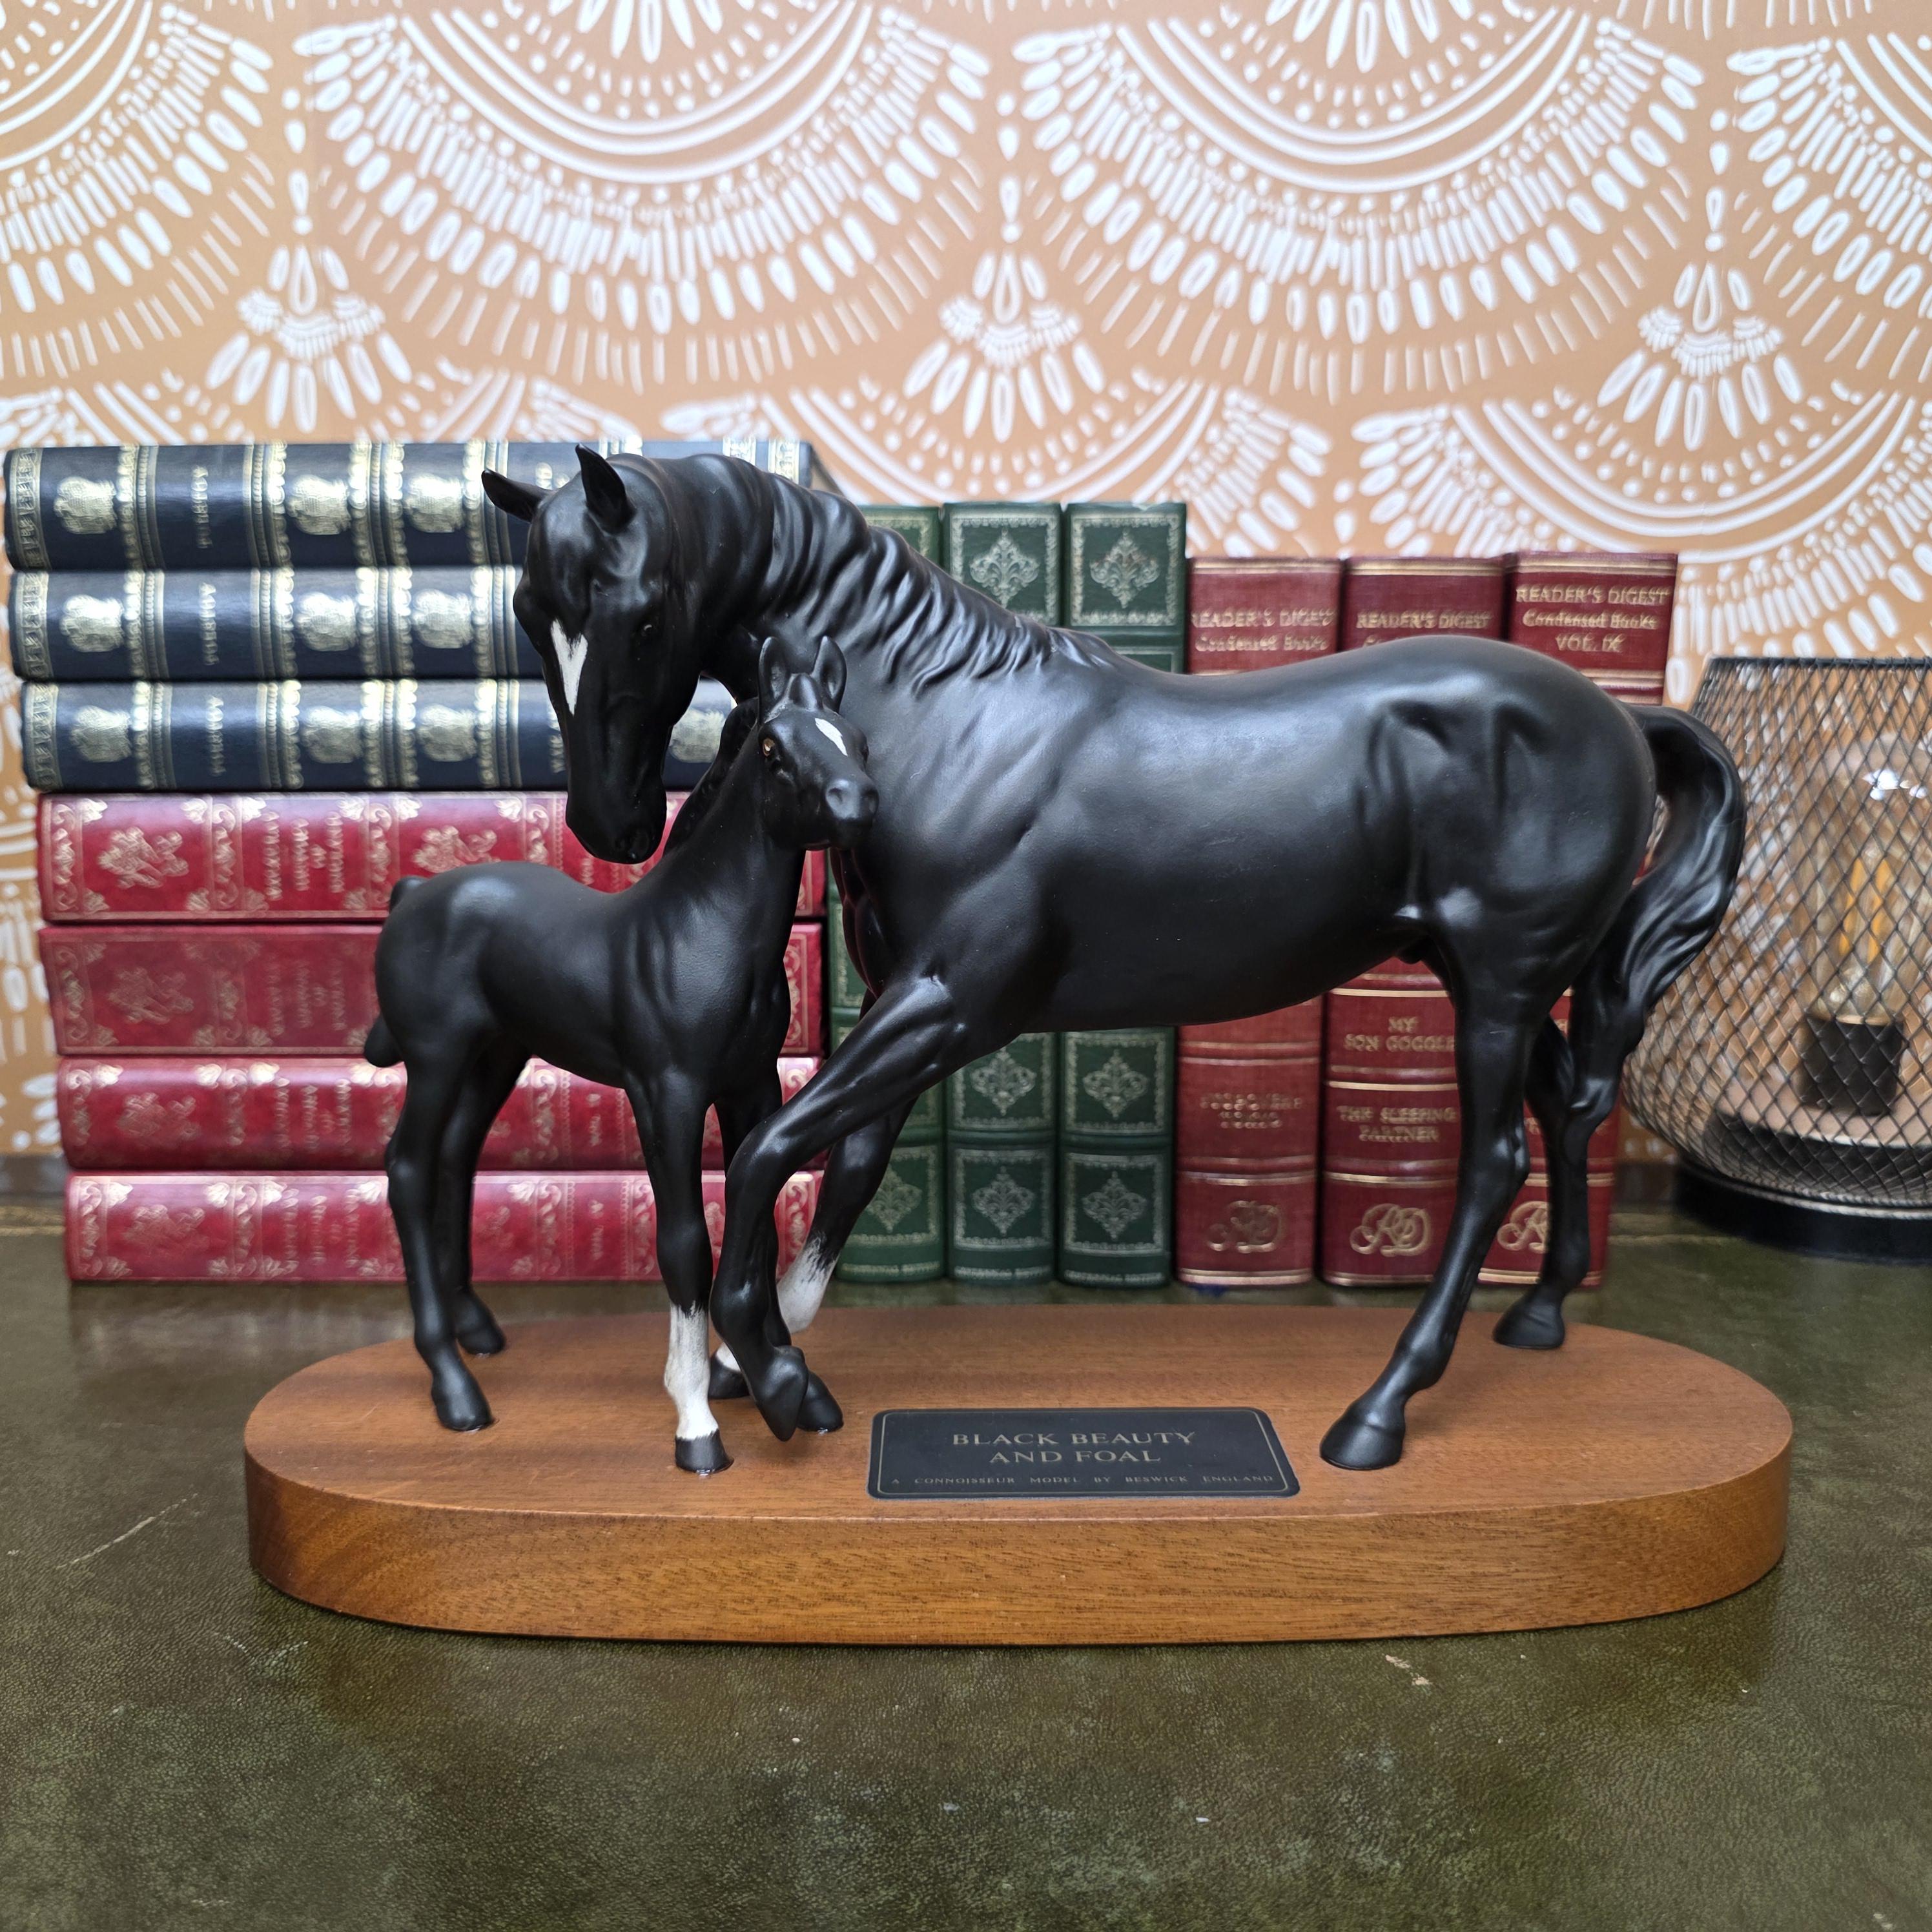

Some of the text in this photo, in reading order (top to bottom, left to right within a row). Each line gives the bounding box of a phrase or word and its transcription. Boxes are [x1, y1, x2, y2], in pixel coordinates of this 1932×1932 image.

[1516, 584, 1672, 606] READER'S DIGEST
[1357, 610, 1492, 629] READER'S DIGEST
[1523, 608, 1610, 628] Condensed
[1388, 1016, 1419, 1033] MY
[1344, 1034, 1381, 1052] SON
[952, 1431, 1195, 1446] BLACK BEAUTY
[989, 1450, 1162, 1464] AND FOAL
[1202, 1475, 1274, 1483] ENGLAND
